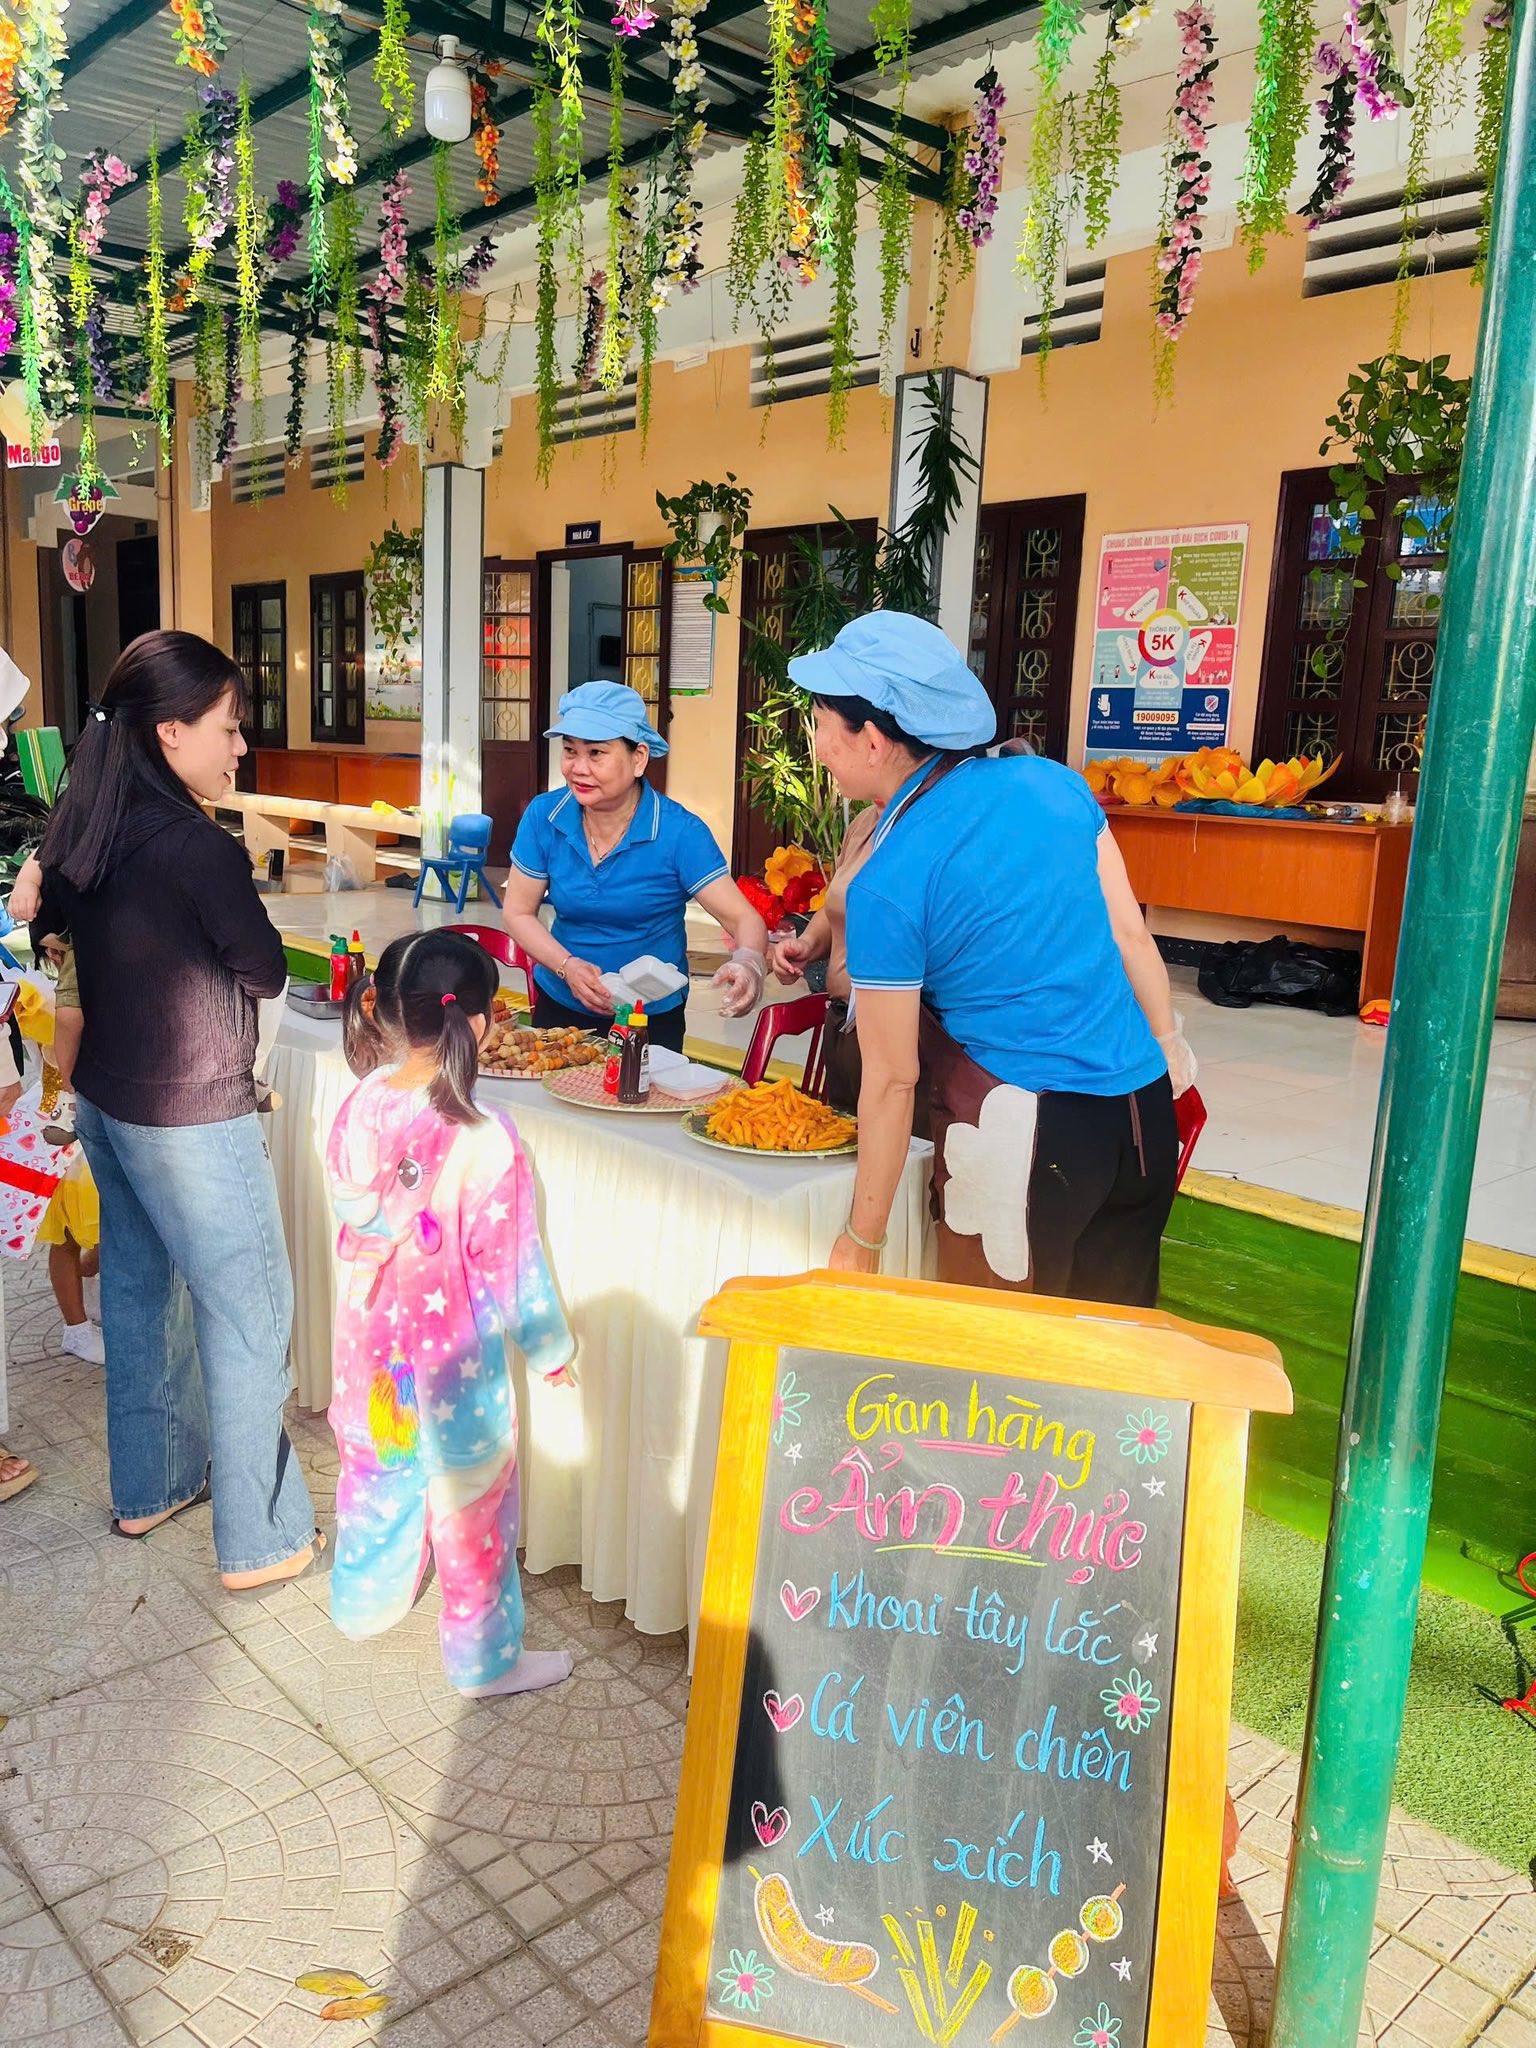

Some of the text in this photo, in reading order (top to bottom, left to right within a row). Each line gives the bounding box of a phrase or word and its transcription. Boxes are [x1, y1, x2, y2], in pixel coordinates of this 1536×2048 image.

[69, 496, 104, 513] Grape
[1151, 634, 1176, 650] 5K
[1136, 713, 1176, 722] 19009095
[846, 1373, 1096, 1489] Gian hàng
[778, 1441, 1148, 1585] Ẩm thực
[827, 1568, 1123, 1675] Khoai tây lắc
[808, 1671, 865, 1744] Cá
[886, 1692, 994, 1762] viên
[796, 1793, 1062, 1896] Xúc xích
